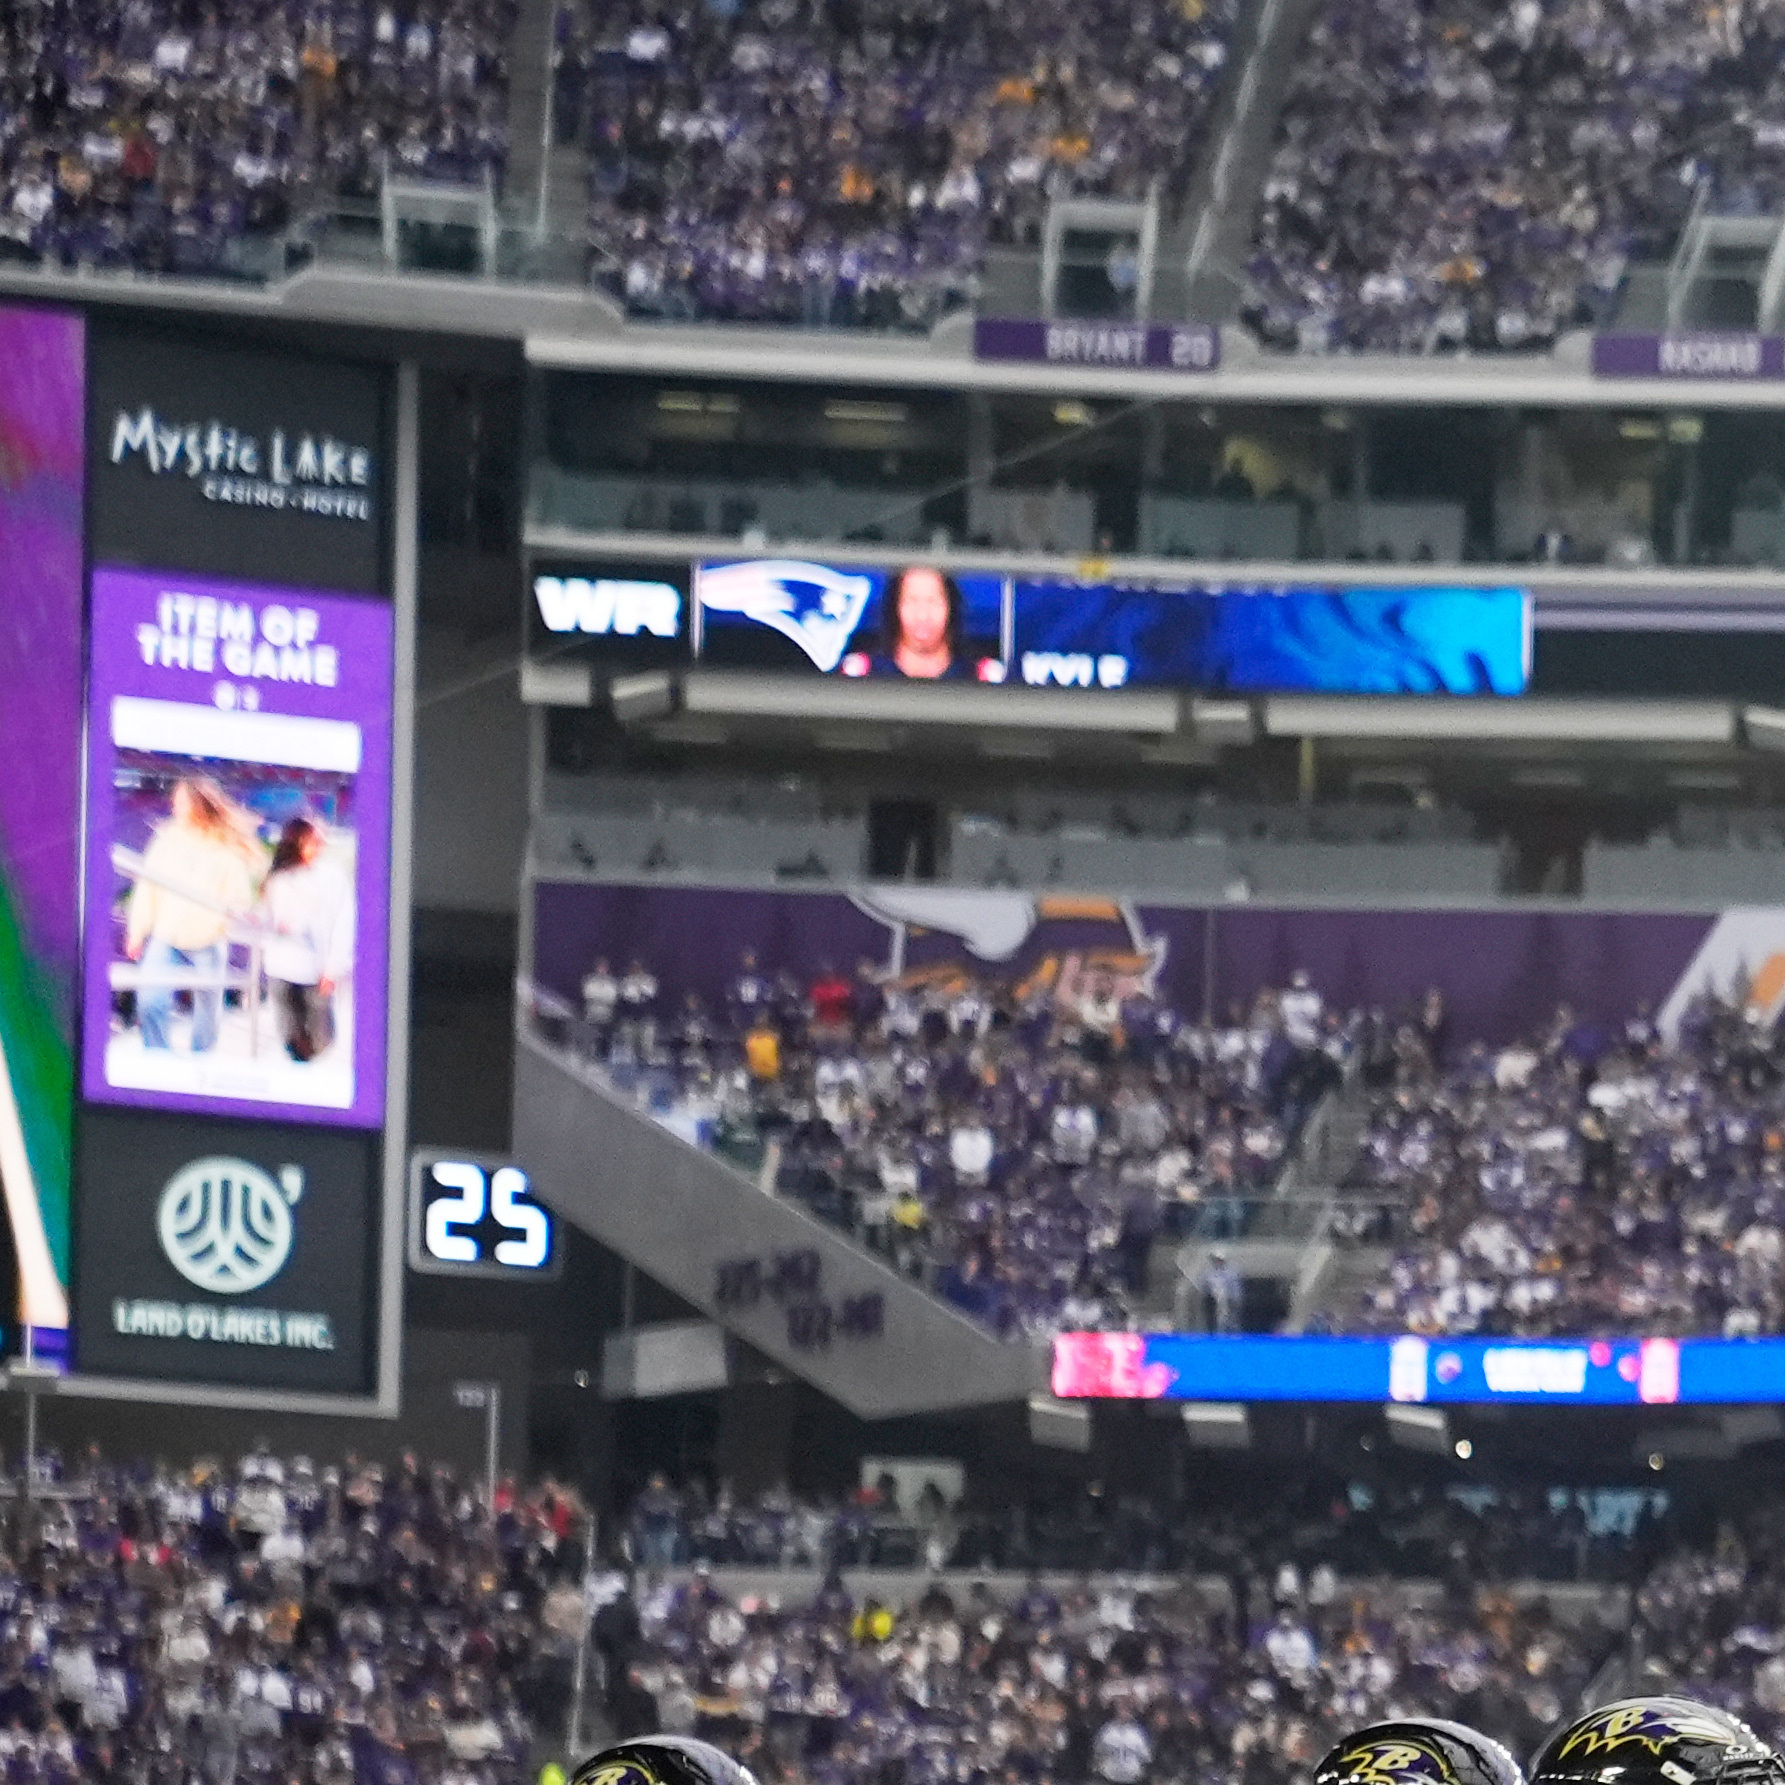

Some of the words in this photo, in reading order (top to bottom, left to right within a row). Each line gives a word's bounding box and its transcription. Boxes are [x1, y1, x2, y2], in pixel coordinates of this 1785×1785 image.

[110, 405, 259, 480] Mystic
[202, 484, 285, 510] CASINO
[302, 497, 369, 521] HOTEL
[157, 591, 254, 642] ITEM
[259, 604, 320, 648] OF
[533, 575, 681, 638] WR
[136, 622, 216, 674] THE
[222, 642, 340, 688] GAME
[426, 1161, 549, 1267] 25
[114, 1299, 181, 1338] LAND
